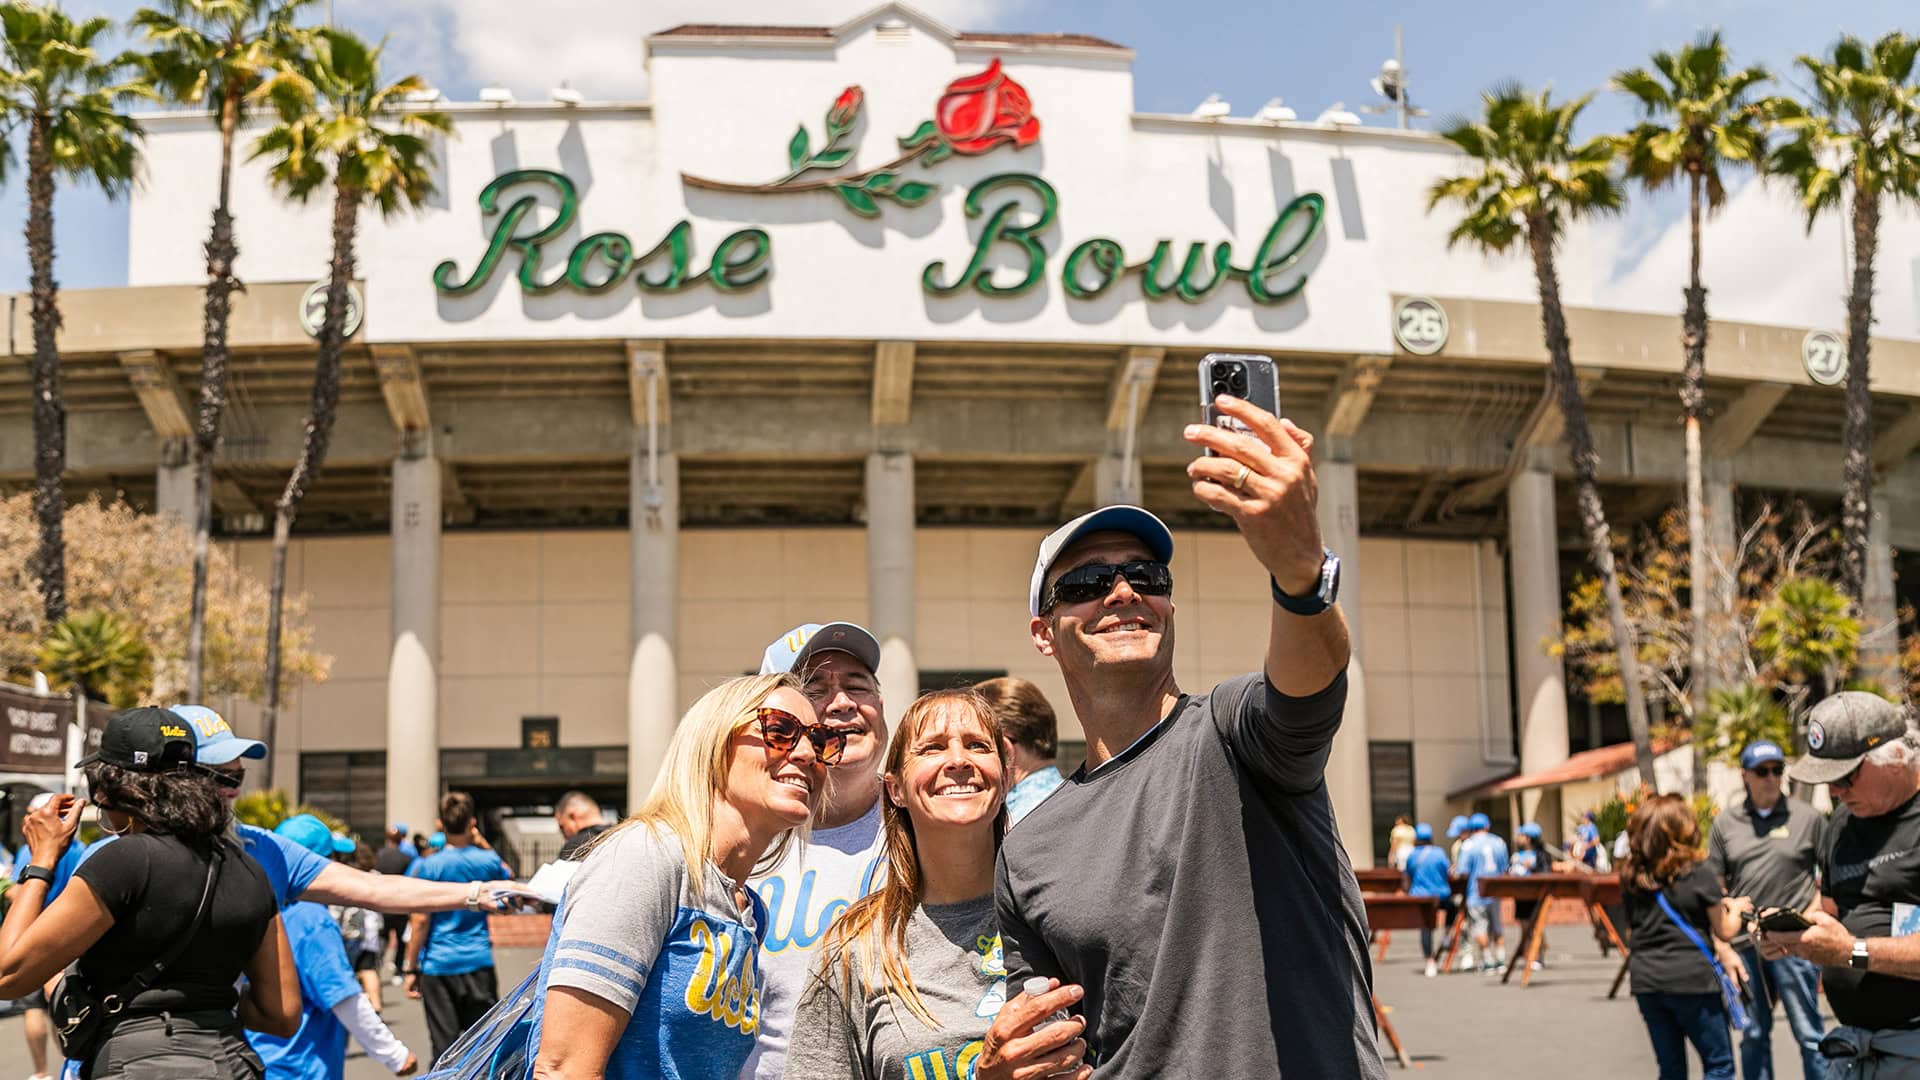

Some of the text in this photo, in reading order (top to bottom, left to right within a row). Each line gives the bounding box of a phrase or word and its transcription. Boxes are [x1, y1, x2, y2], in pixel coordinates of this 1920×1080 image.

[433, 169, 1326, 304] Rose Bowl
[1400, 307, 1442, 340] 26
[1808, 340, 1842, 371] 27
